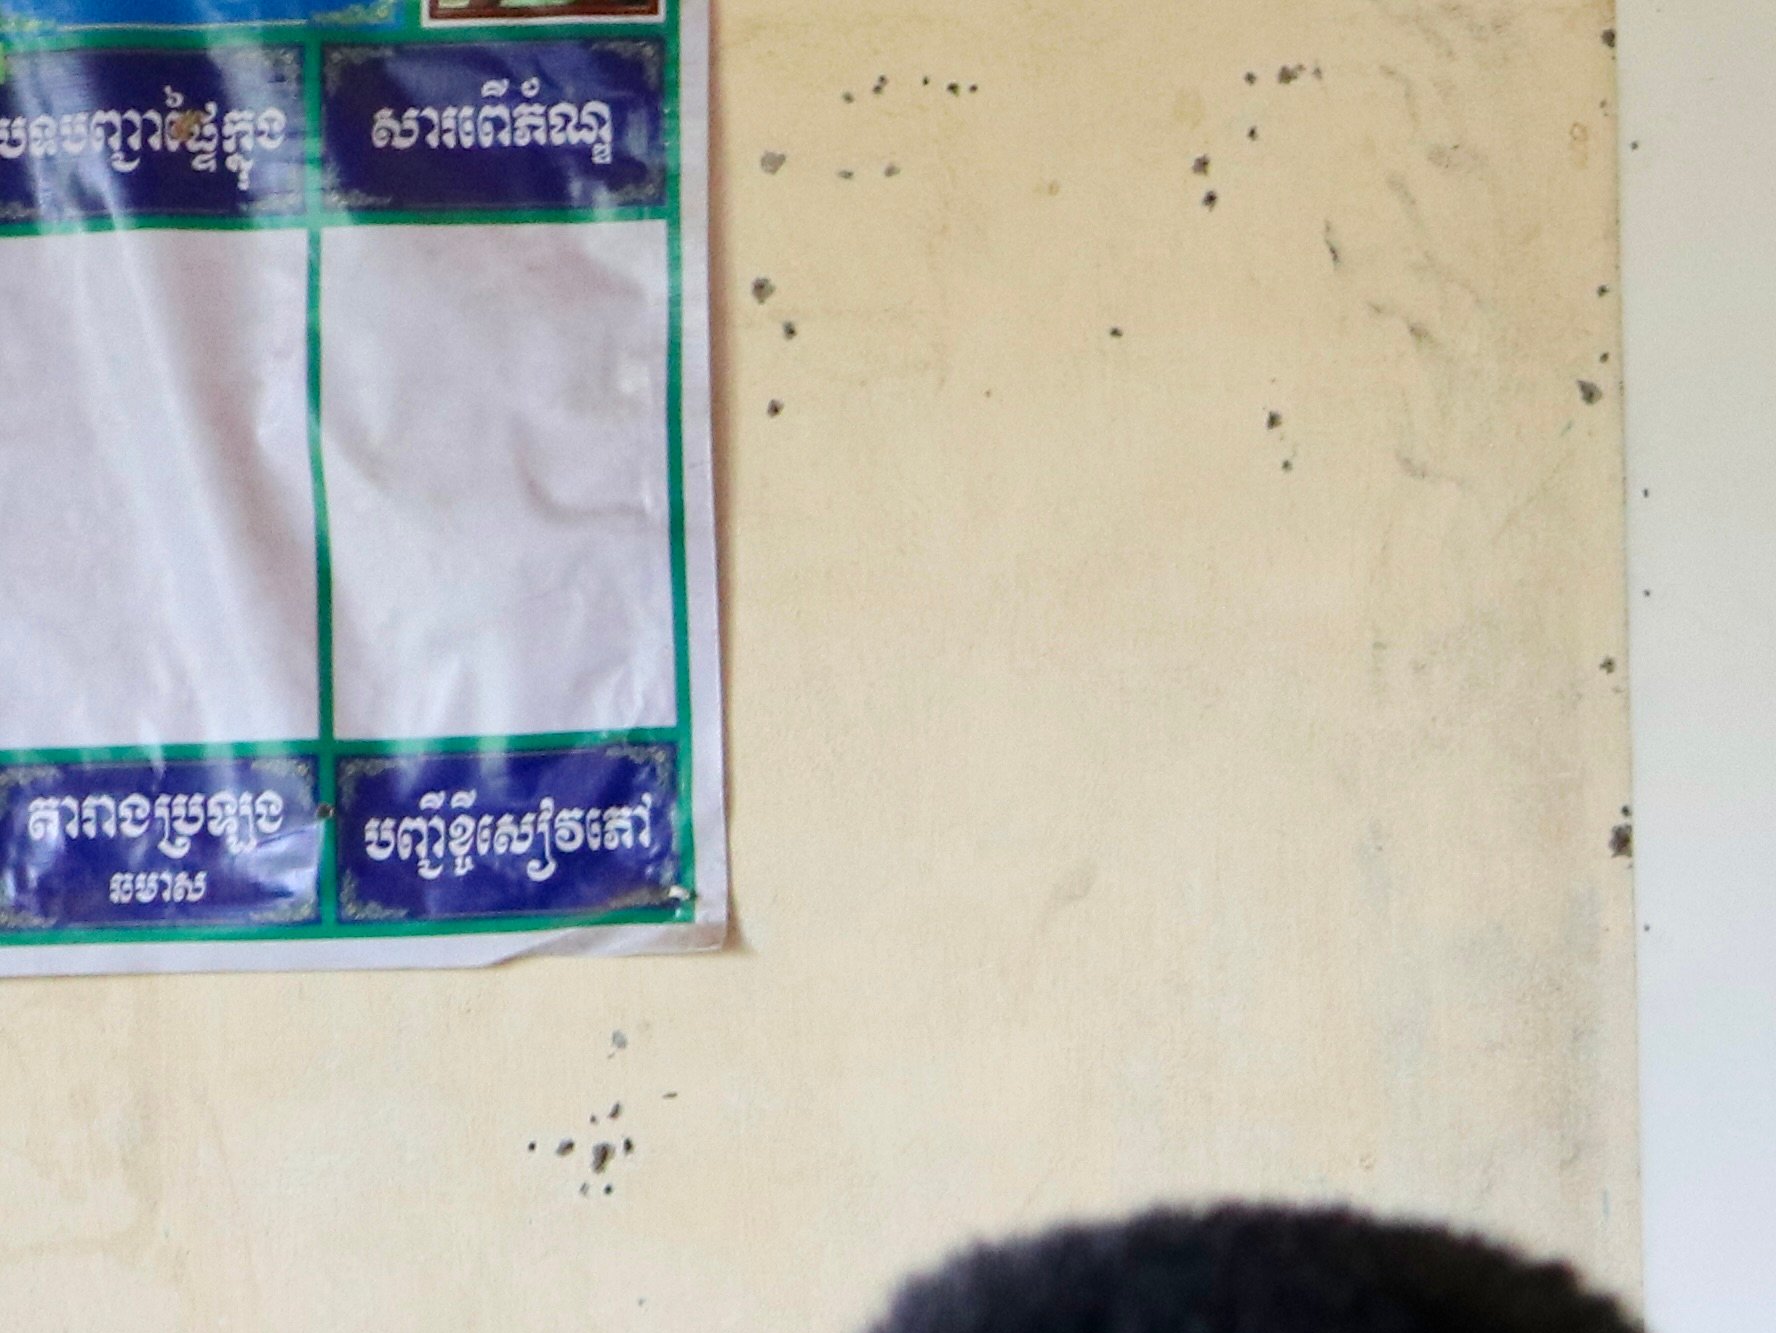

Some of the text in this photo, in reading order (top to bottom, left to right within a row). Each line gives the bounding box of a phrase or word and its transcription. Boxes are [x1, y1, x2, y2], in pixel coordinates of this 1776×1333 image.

[27, 789, 284, 860] តារាងប្រឡង
[363, 788, 653, 882] បញ្ជីខ្ចីសៀវភៅ
[109, 870, 208, 905] ឆមាស
